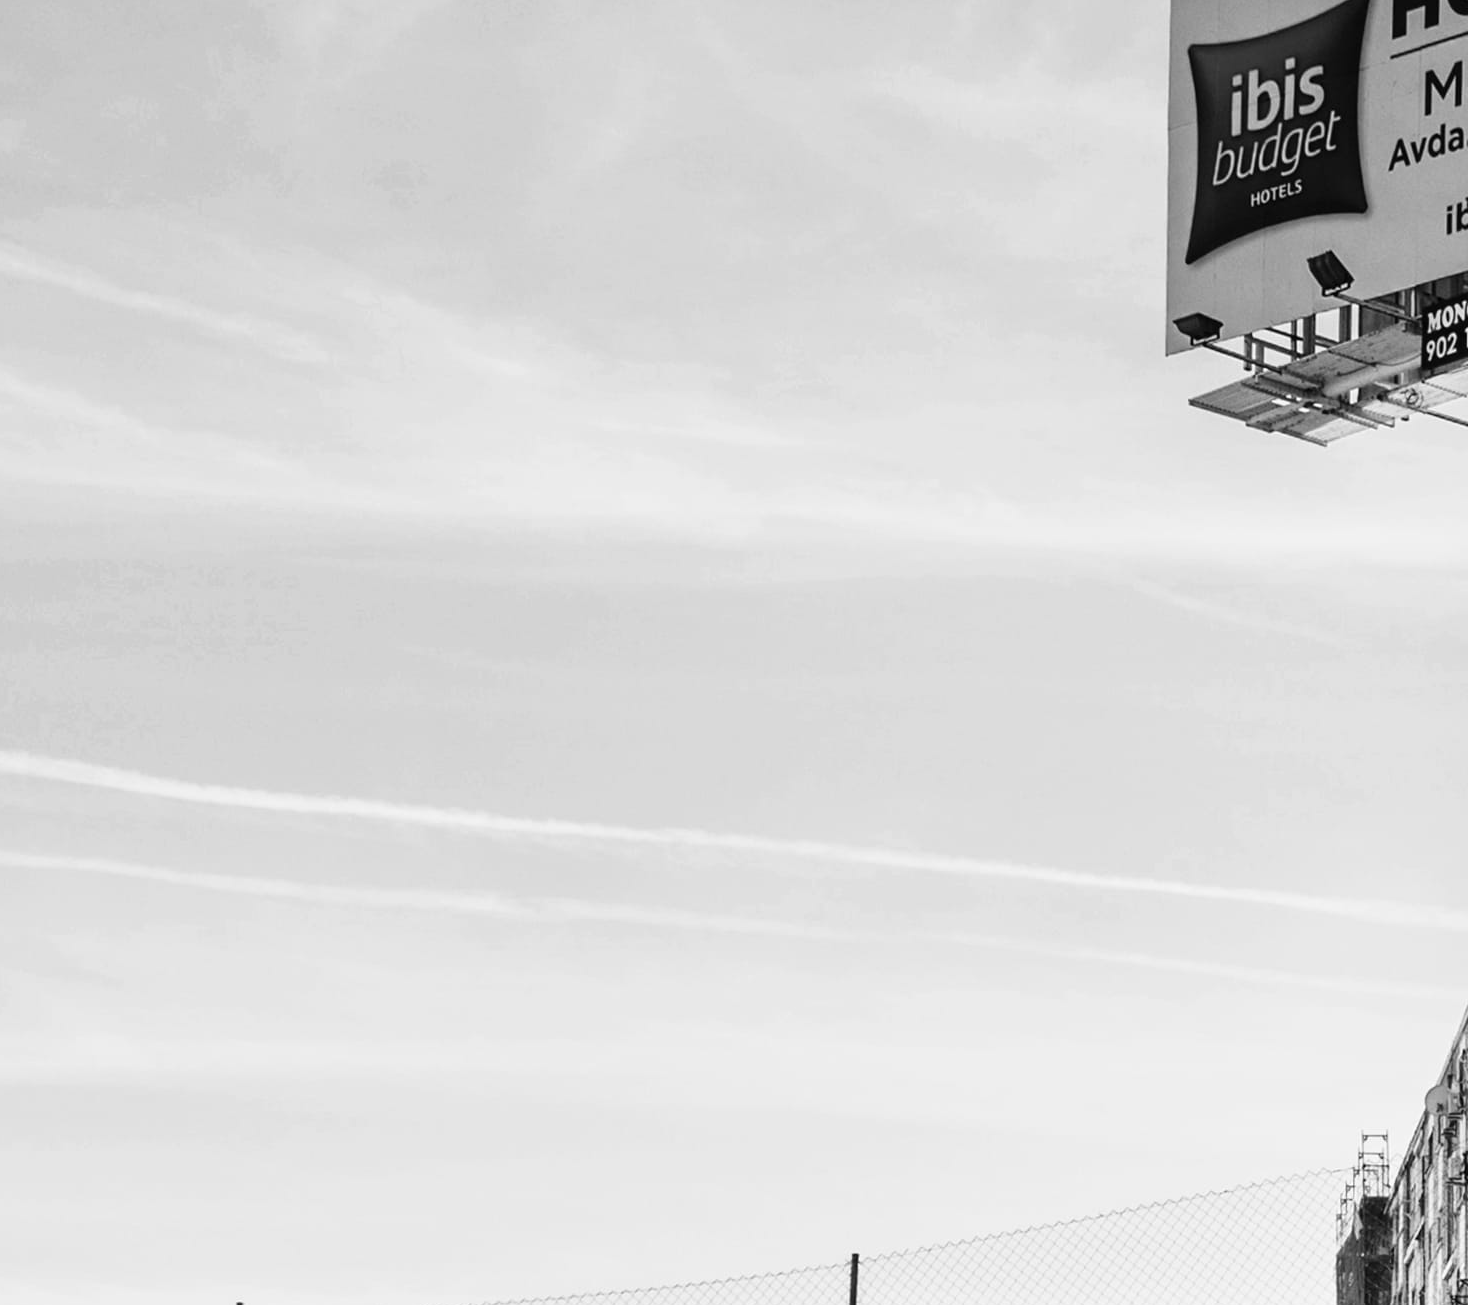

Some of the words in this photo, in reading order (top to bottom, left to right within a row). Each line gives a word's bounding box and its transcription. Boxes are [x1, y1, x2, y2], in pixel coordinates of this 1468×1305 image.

[1230, 56, 1325, 137] ibis
[1212, 110, 1341, 186] budget
[1250, 179, 1303, 208] HOTELS
[1426, 332, 1458, 362] 902
